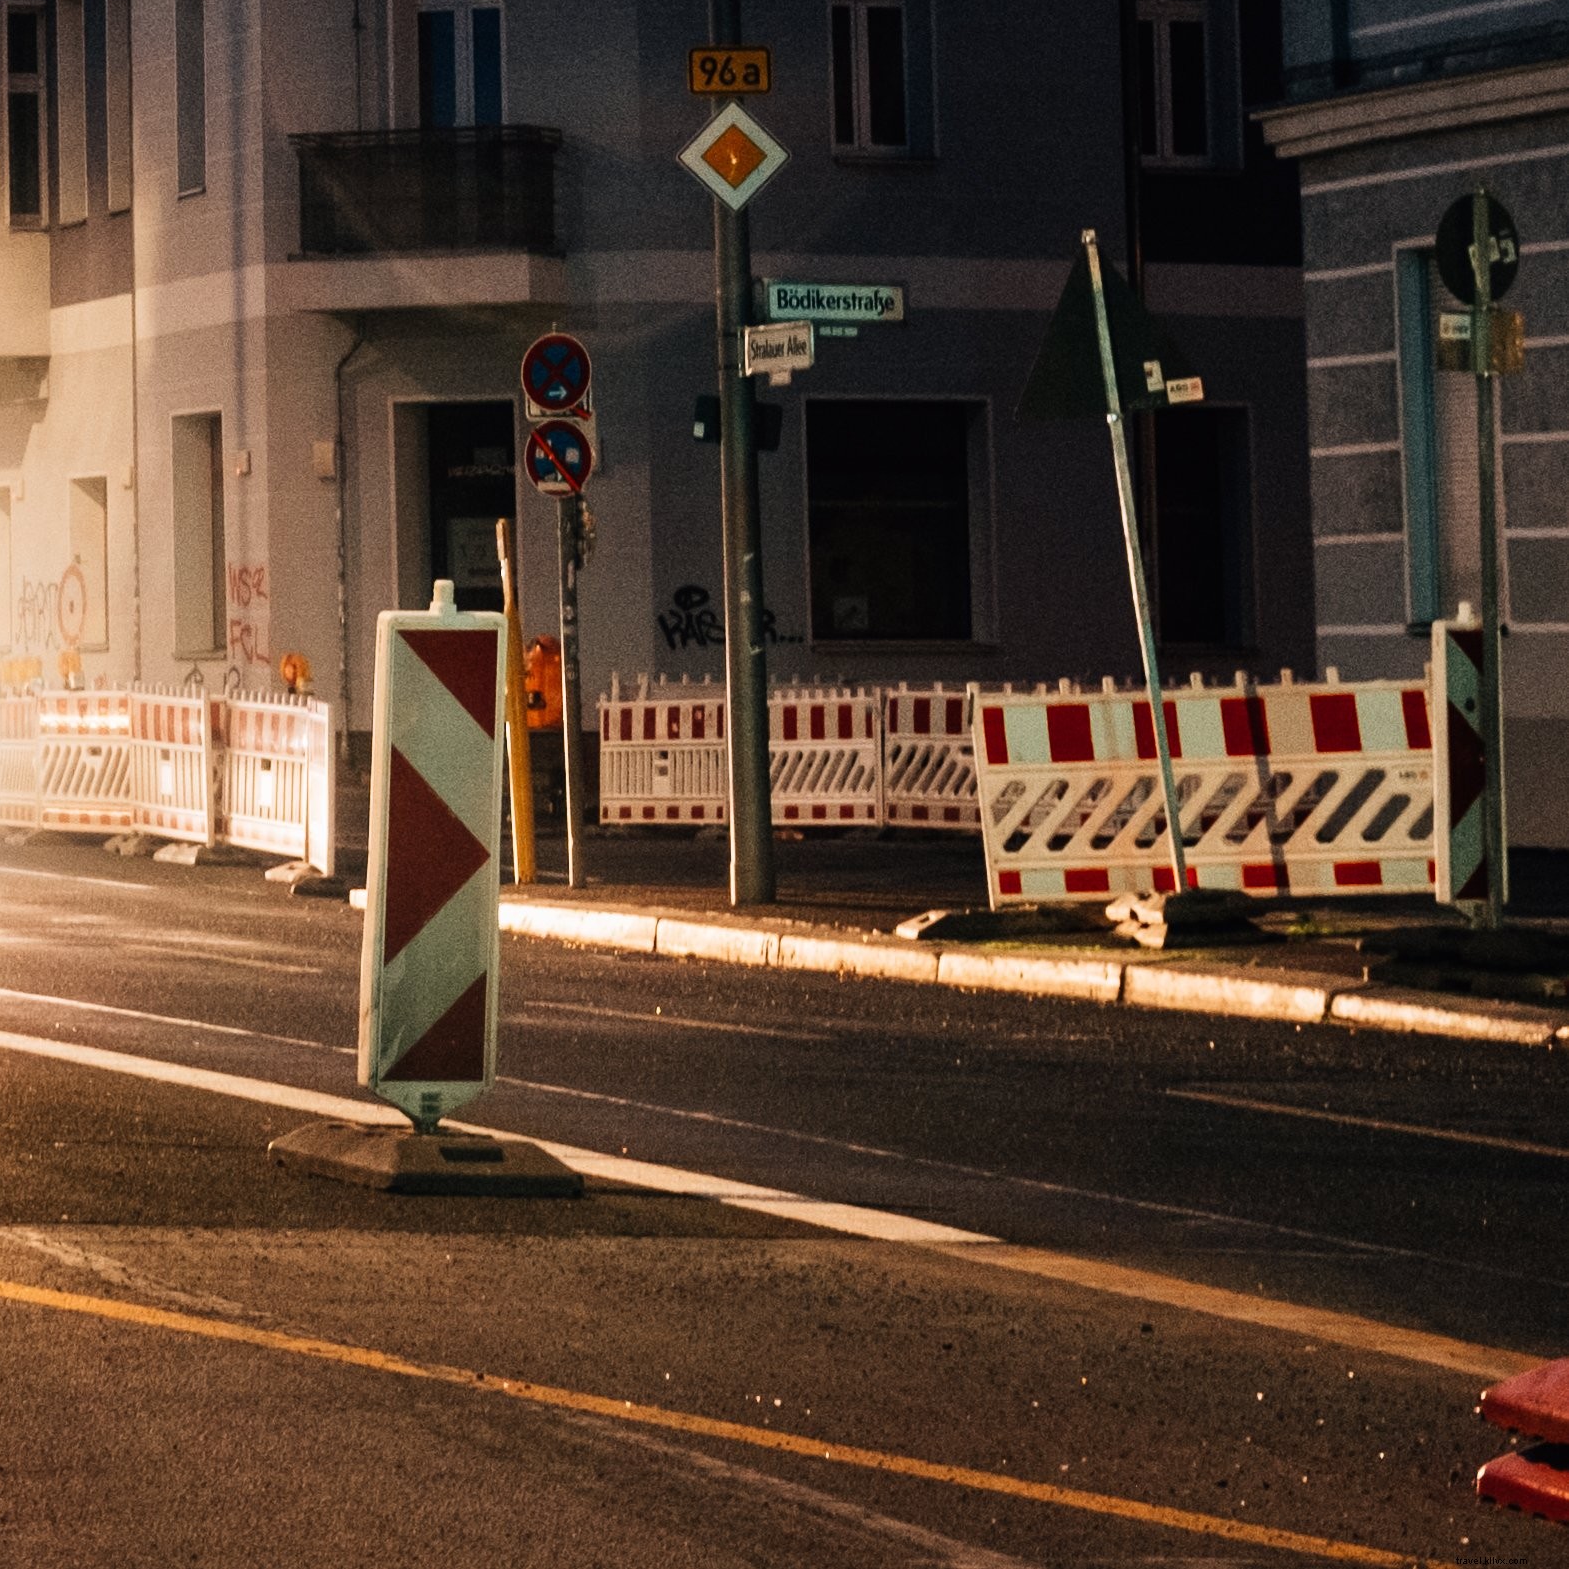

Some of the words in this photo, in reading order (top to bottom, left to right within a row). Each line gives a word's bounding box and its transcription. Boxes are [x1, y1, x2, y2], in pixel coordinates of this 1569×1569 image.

[701, 55, 735, 86] 96
[744, 63, 760, 85] a
[777, 288, 894, 315] Bödikerstraße
[750, 340, 784, 360] Stralauer
[787, 335, 807, 356] Allee
